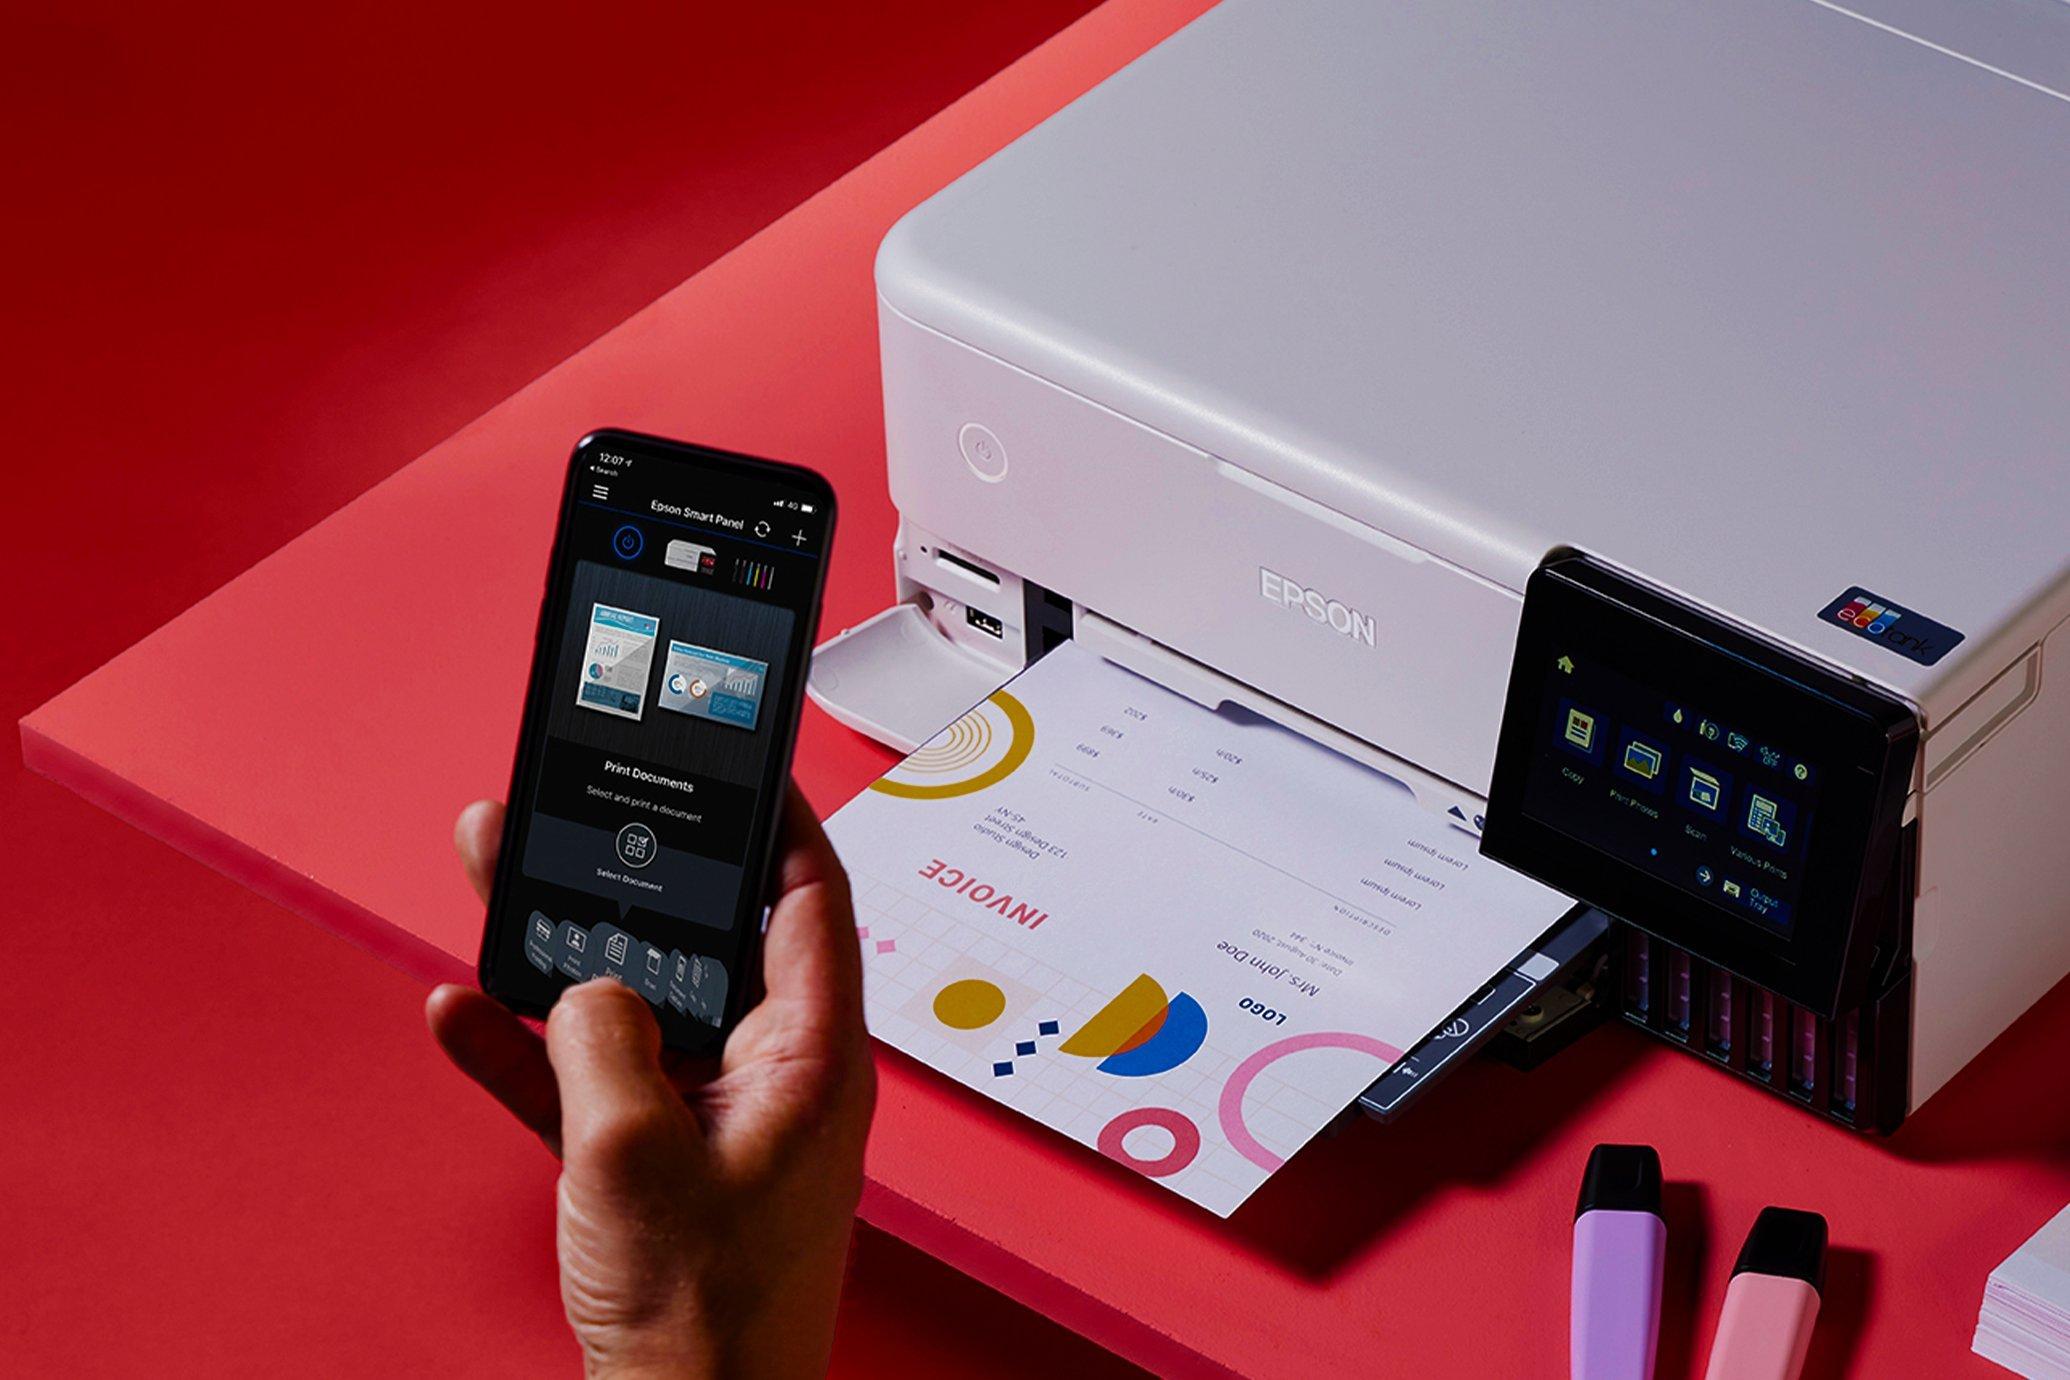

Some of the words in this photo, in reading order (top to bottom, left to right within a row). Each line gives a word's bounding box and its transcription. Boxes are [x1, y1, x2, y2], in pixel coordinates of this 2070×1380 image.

[599, 453, 624, 466] 12:07
[650, 499, 682, 519] Epson
[683, 507, 714, 524] Smart
[715, 514, 745, 530] Panel
[788, 500, 799, 511] 4G
[1260, 566, 1377, 649] EPSON
[604, 760, 631, 776] Print
[631, 768, 694, 793] Documents
[1048, 768, 1091, 792] SUBTOTAL
[1561, 767, 1585, 786] Copy
[586, 784, 612, 800] Select
[613, 793, 630, 805] and
[630, 798, 651, 811] print
[659, 805, 702, 823] document
[995, 805, 1026, 824] 45-NY
[972, 823, 1005, 844] Studio
[984, 814, 1015, 834] Street
[1684, 824, 1708, 842] Scan
[1004, 838, 1041, 860] Design
[1014, 829, 1049, 851] Design
[1047, 845, 1068, 859] 123
[1437, 853, 1469, 871] Lorem
[596, 868, 622, 882] Select
[622, 875, 663, 892] Document
[1414, 872, 1446, 891] Lorem
[917, 858, 1049, 930] INVOICE
[1390, 892, 1422, 911] Lorem
[1334, 905, 1392, 936] DESCRIPTION
[1215, 940, 1249, 963] Doe
[1323, 947, 1355, 967] Invoice
[1249, 956, 1289, 981] John
[1289, 974, 1320, 997] Mrs.
[1238, 997, 1288, 1026] LOGO
